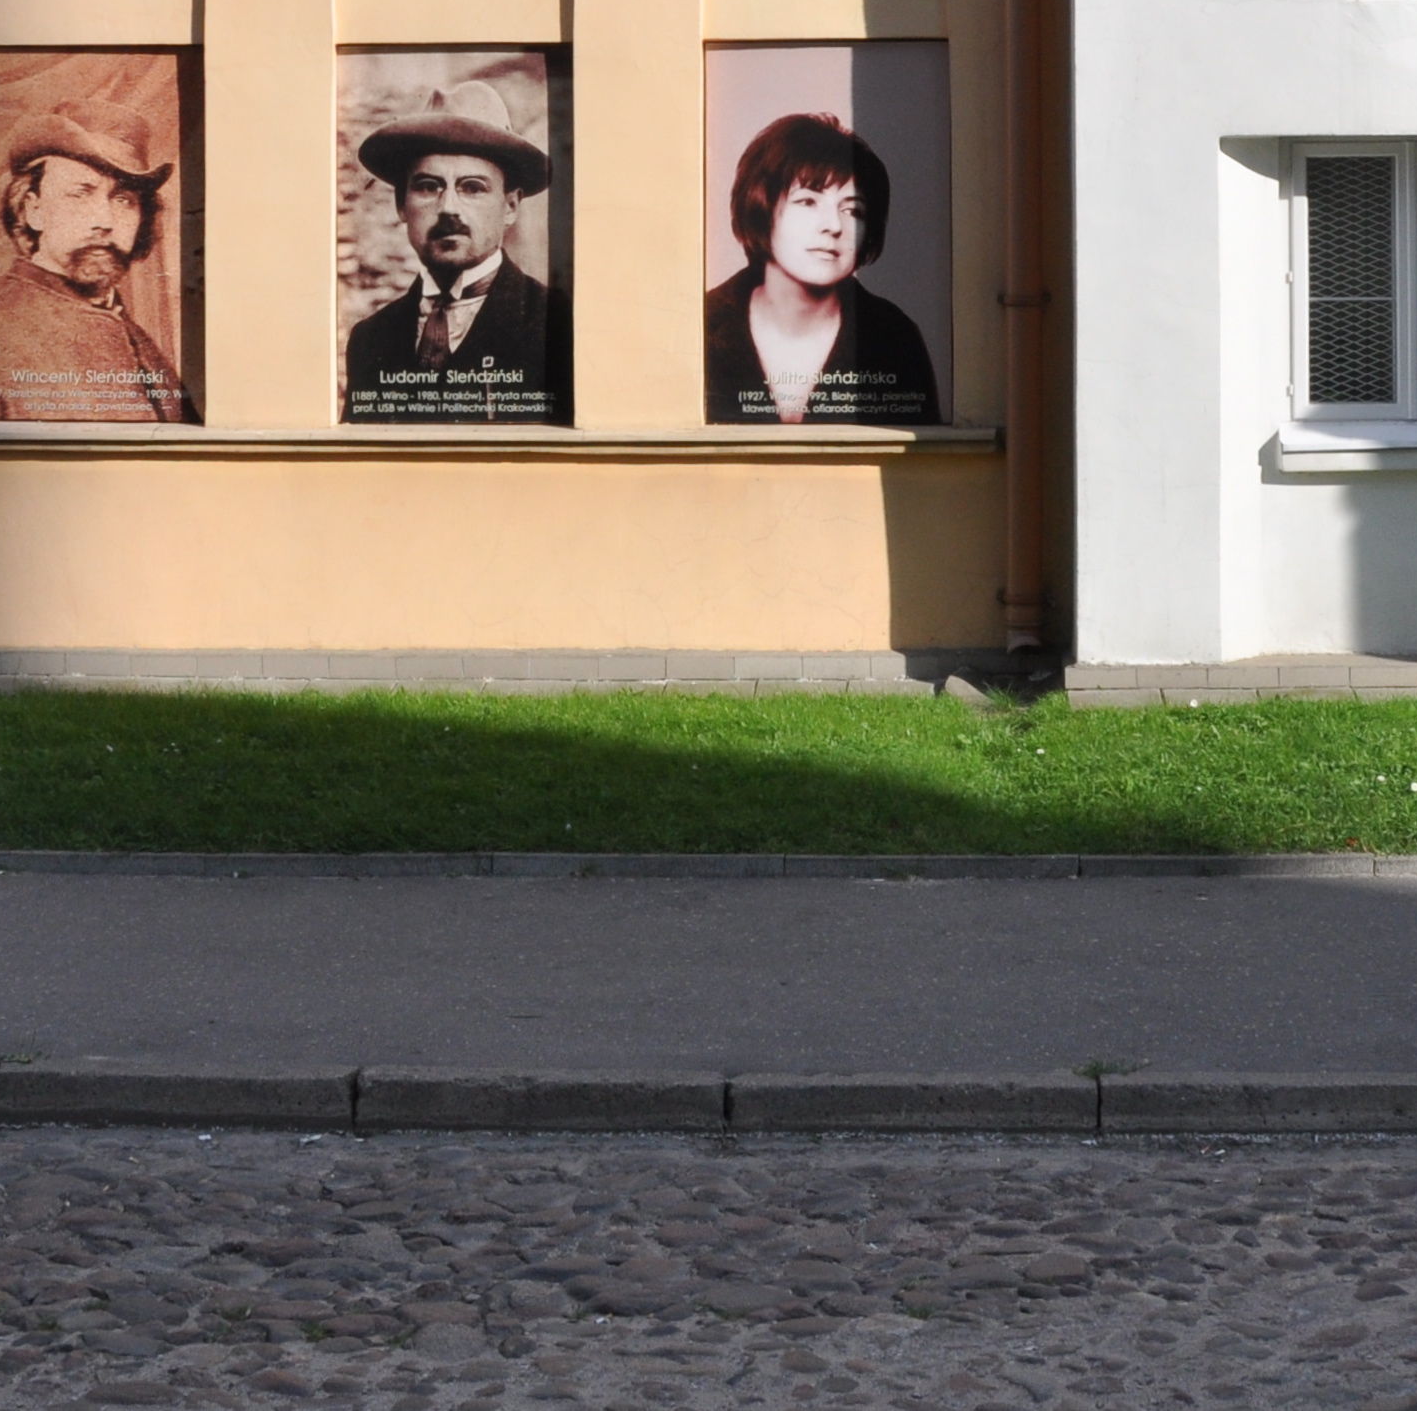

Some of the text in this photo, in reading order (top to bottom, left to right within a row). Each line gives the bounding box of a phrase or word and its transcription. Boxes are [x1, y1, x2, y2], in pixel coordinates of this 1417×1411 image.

[11, 370, 164, 386] Wincenty Sleńdziński
[379, 369, 524, 384] Ludomir Sleńdziński
[763, 370, 897, 385] Julitta Sleńdzińska
[382, 391, 409, 401] Wilno
[486, 391, 521, 403] artysta
[352, 403, 376, 414] prof.
[377, 403, 396, 413] USB
[396, 404, 407, 413] w
[408, 403, 436, 413] Wilnie
[442, 402, 496, 413] Politechniki
